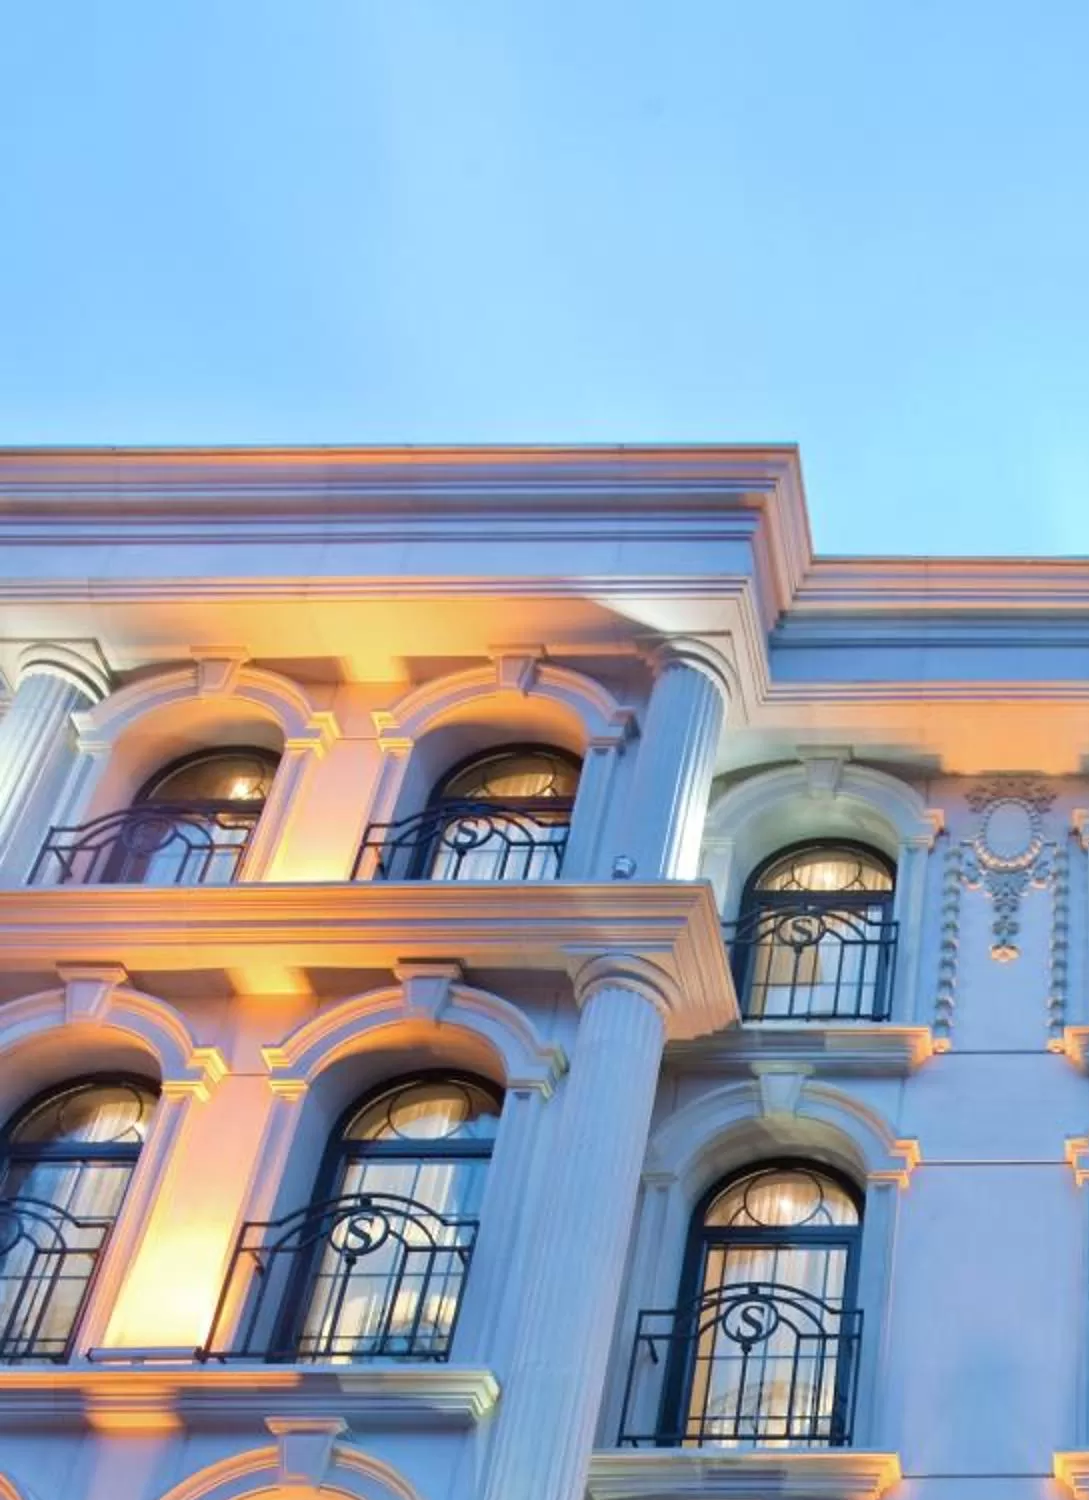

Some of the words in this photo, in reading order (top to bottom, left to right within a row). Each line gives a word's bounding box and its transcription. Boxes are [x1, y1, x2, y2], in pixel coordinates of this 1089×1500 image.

[456, 819, 478, 844] S
[791, 917, 812, 942] S
[346, 1216, 372, 1251] S
[738, 1305, 765, 1339] S
